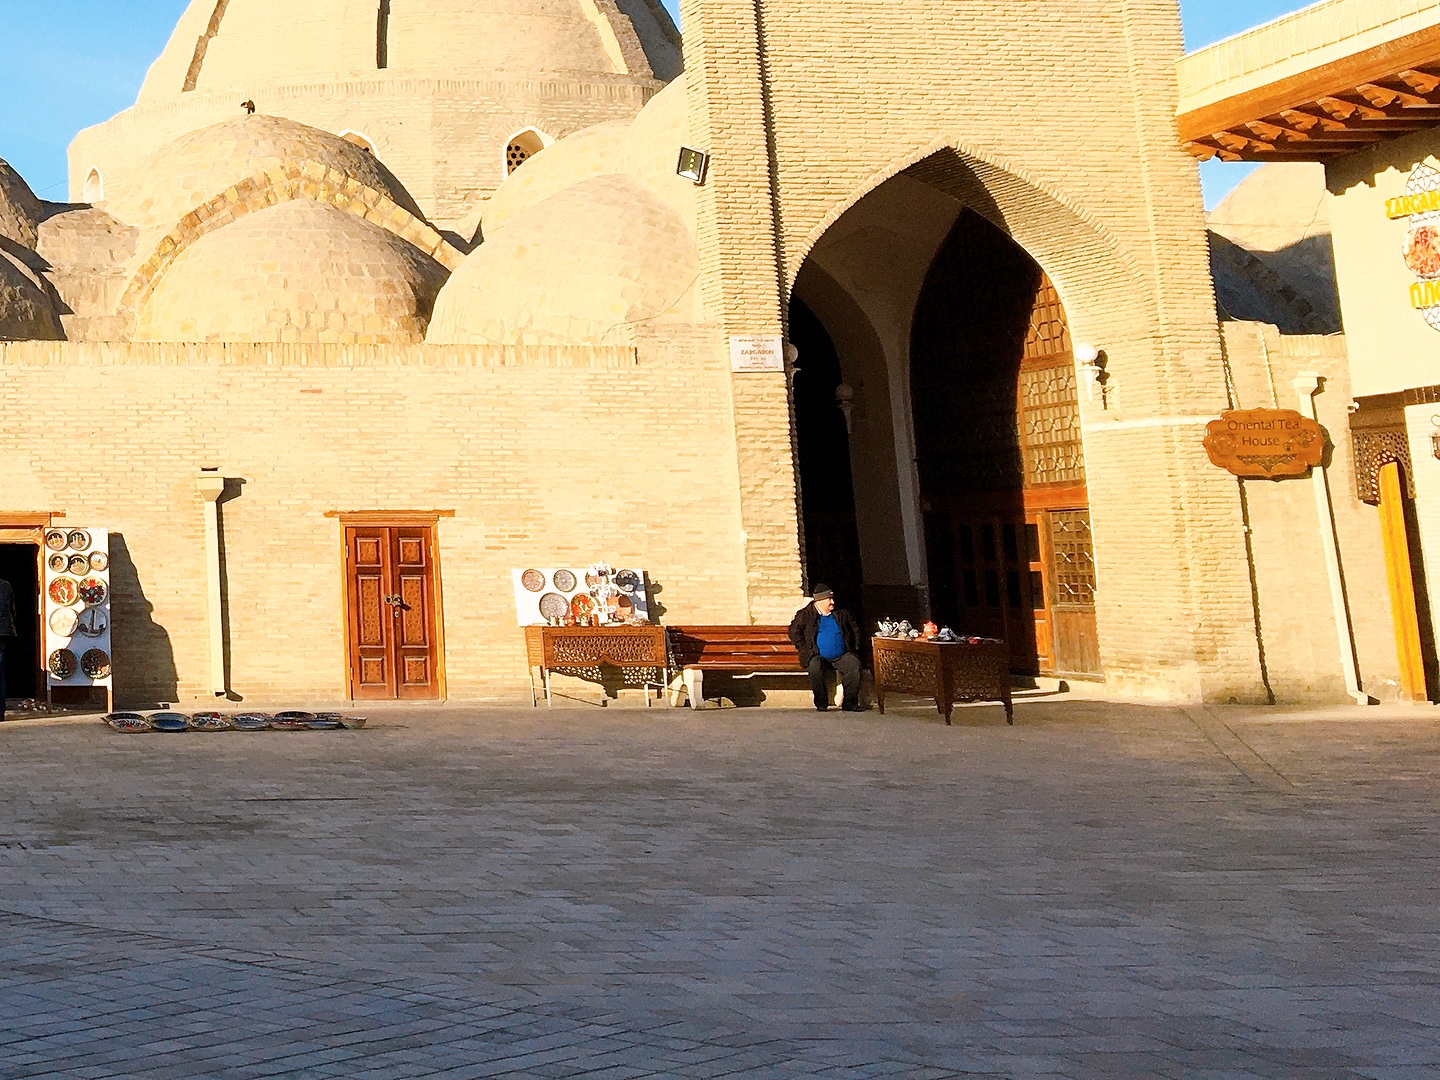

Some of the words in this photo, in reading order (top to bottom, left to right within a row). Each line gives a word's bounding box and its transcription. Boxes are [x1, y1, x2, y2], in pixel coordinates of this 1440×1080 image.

[1385, 192, 1440, 218] ZARGAR
[1228, 419, 1275, 430] Oriental
[1278, 419, 1299, 430] Tea
[1242, 436, 1280, 446] House
